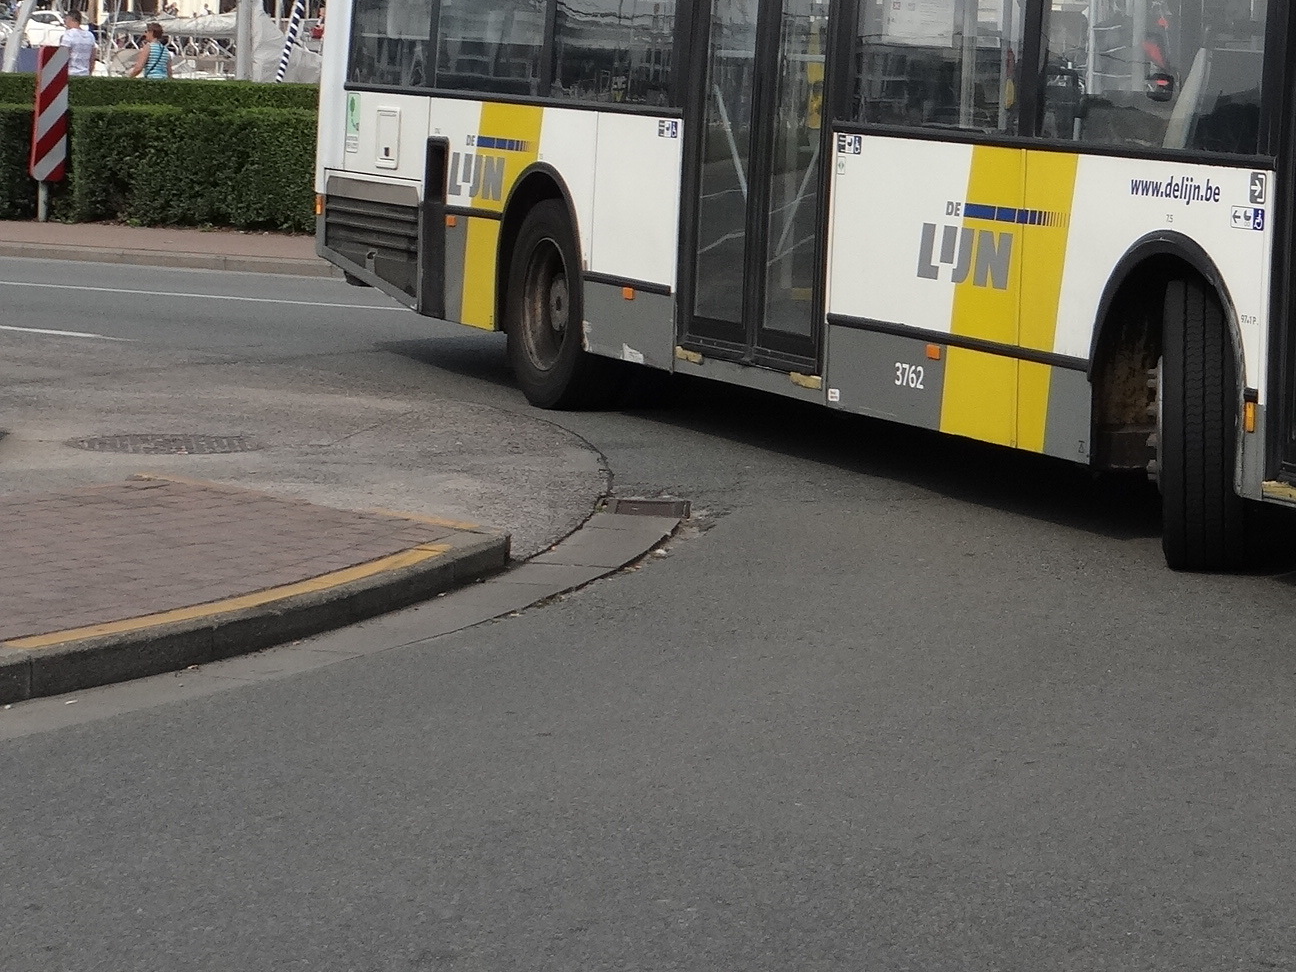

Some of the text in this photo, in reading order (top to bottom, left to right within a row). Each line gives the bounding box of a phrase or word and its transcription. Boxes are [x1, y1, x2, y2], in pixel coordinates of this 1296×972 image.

[466, 134, 476, 146] DE
[448, 151, 506, 202] LIJN
[1130, 175, 1220, 206] www.delijn.be
[945, 200, 961, 217] DE
[917, 222, 1013, 291] LIJN
[894, 361, 924, 389] 3762
